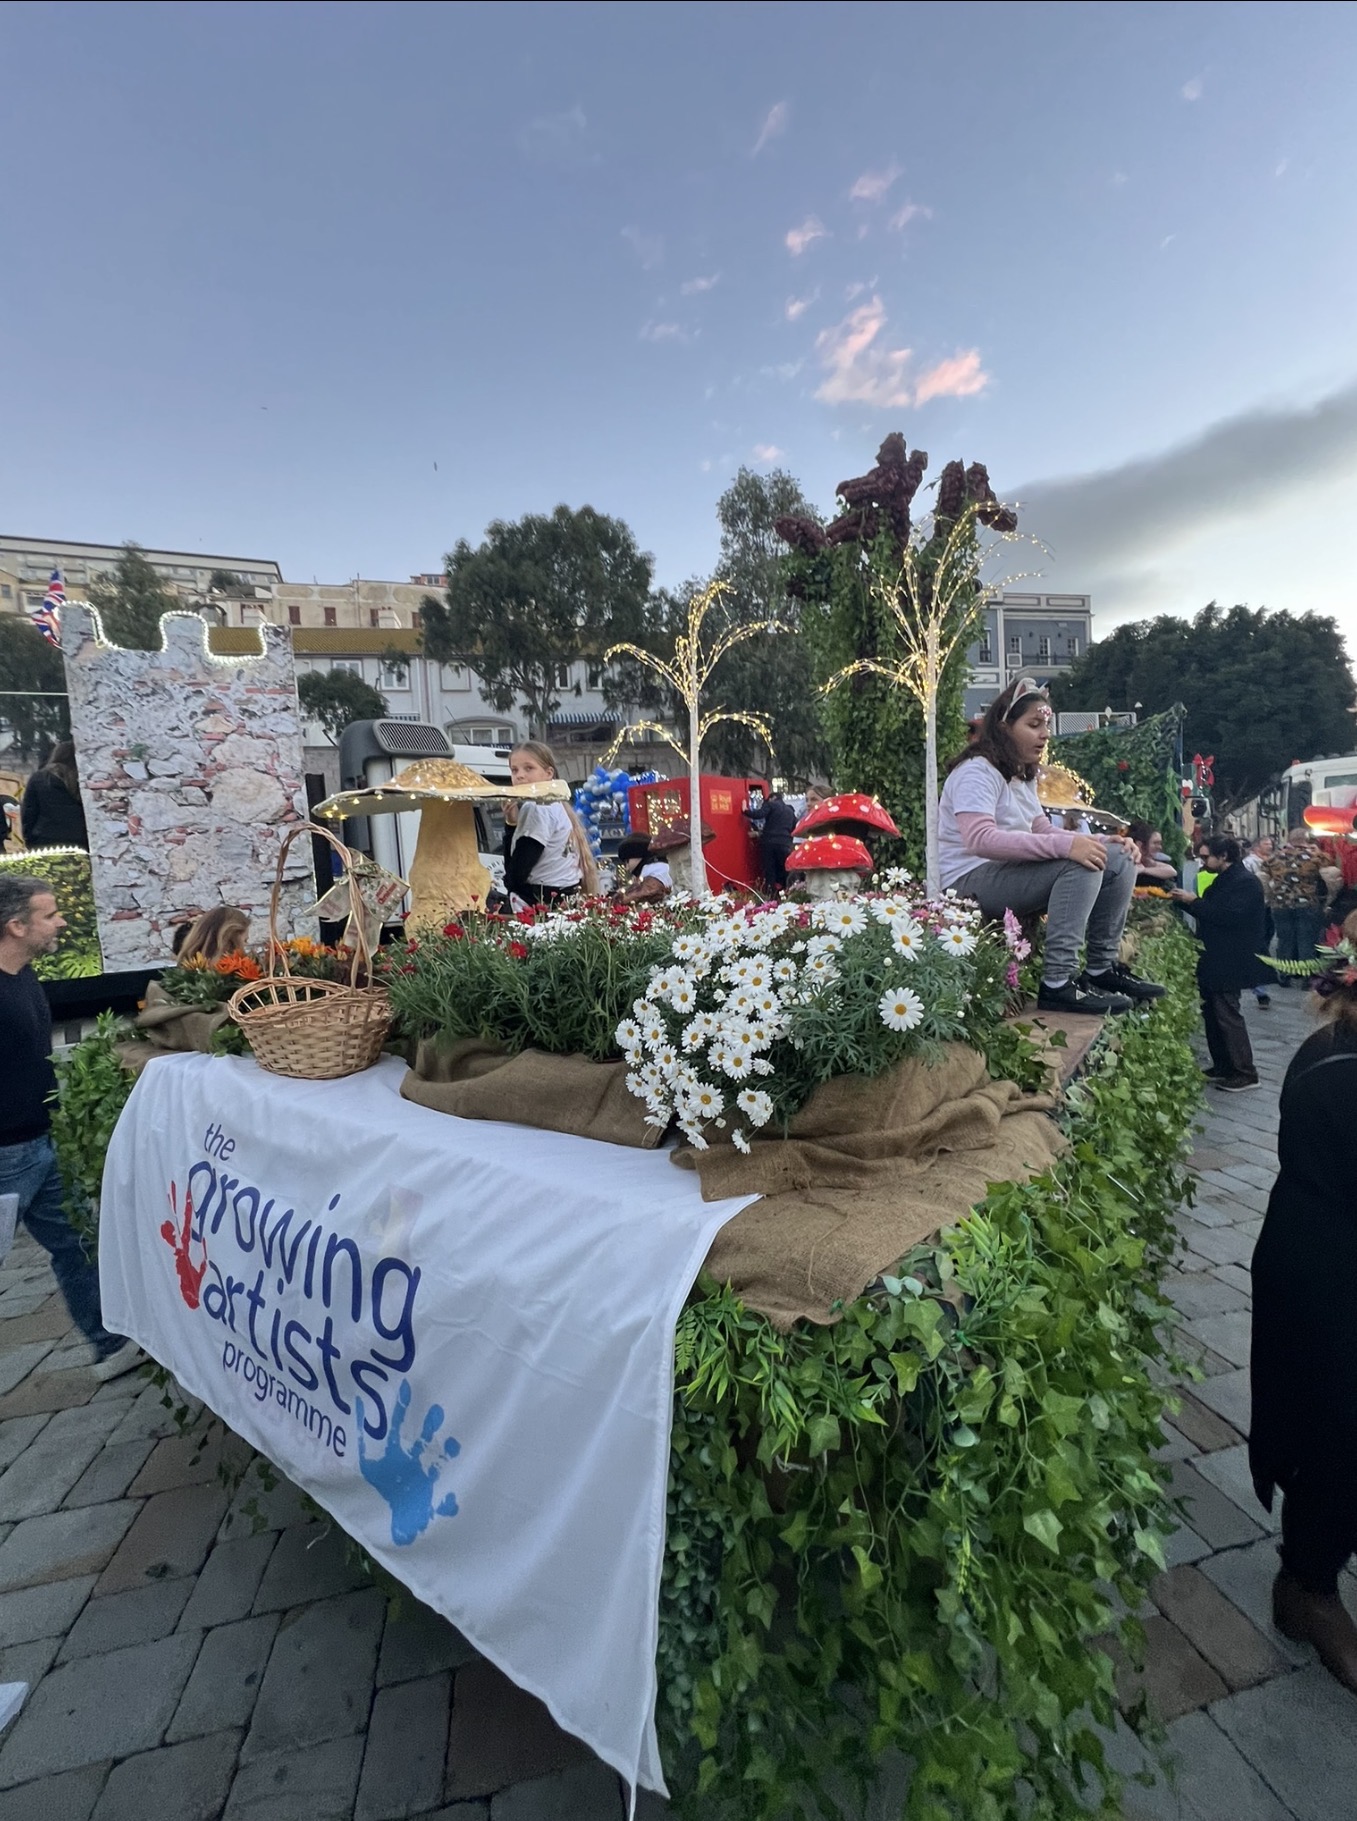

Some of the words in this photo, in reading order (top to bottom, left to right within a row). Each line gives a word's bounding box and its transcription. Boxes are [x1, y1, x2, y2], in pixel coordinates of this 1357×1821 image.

[204, 1122, 236, 1161] the
[188, 1160, 422, 1374] growing
[202, 1259, 389, 1441] artists
[222, 1340, 347, 1457] programme
